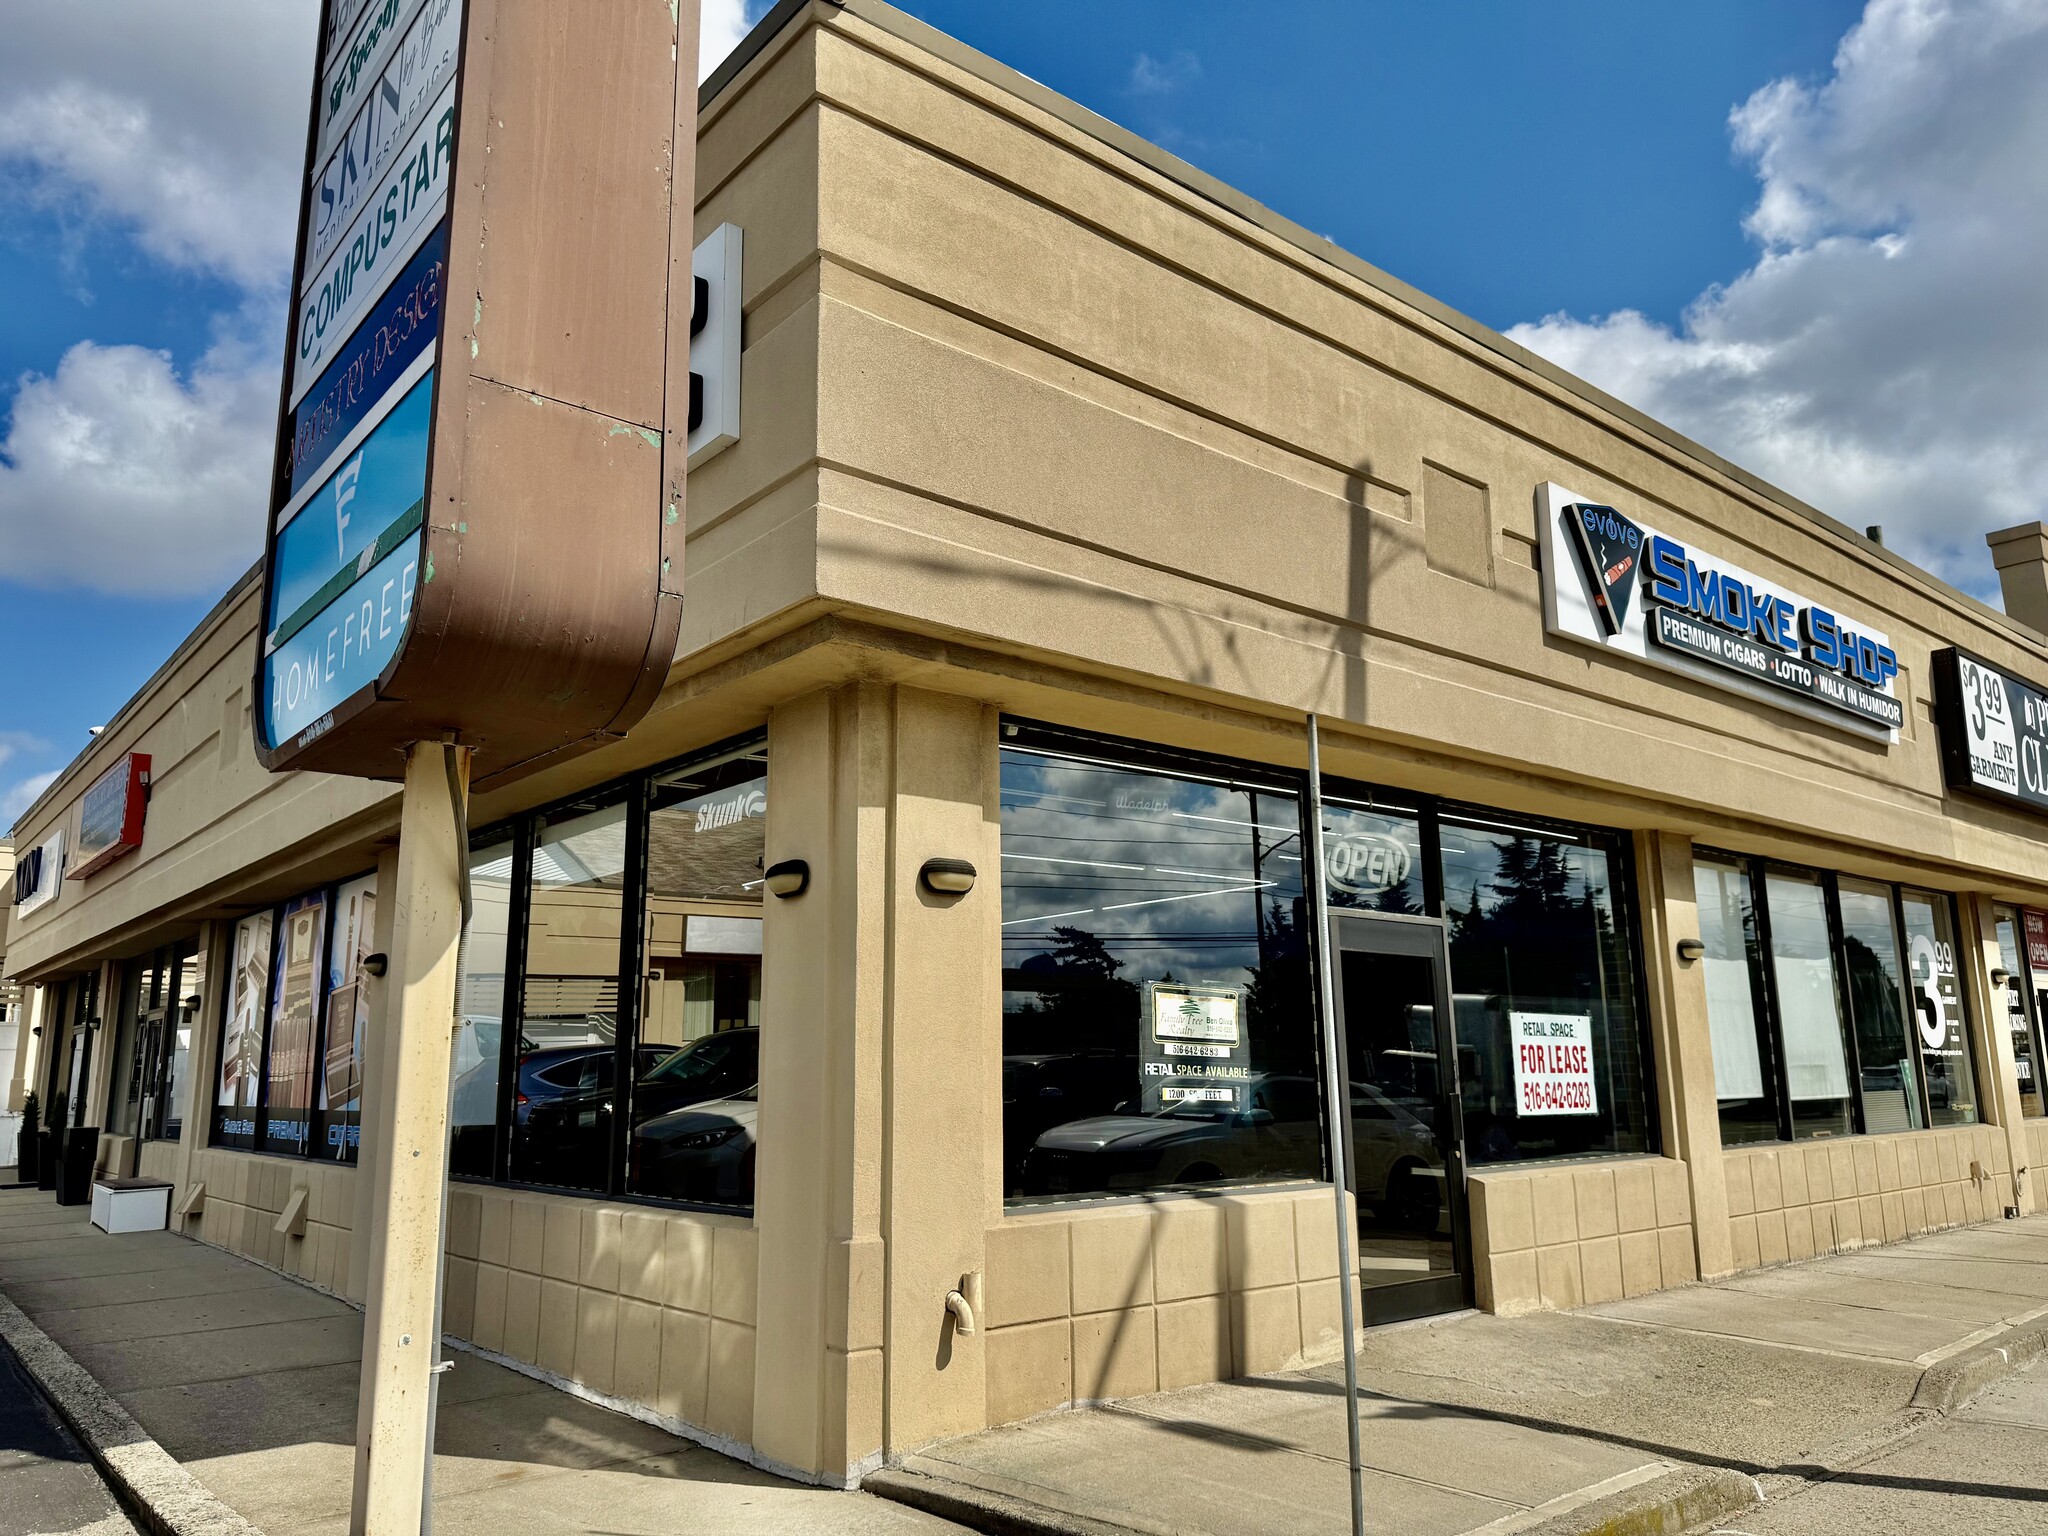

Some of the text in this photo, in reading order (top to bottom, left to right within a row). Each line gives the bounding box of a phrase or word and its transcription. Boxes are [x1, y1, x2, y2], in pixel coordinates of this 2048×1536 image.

[318, 41, 404, 236] SKIN
[301, 106, 454, 360] COMPUSTAR
[1650, 535, 1898, 689] SMOKE SHOP
[271, 560, 415, 726] HOMEFREE
[1663, 615, 1901, 722] PREMIUM CIGARS LOTTO WALK IN HUMIDOR
[1993, 741, 2013, 764] ANY
[1970, 755, 2016, 786] GARMENT
[694, 793, 746, 833] Skunk
[1330, 841, 1401, 886] OPEN
[1167, 1024, 1196, 1036] Realty
[1186, 1014, 1203, 1025] Tree
[1206, 1016, 1217, 1024] Ben
[1523, 1022, 1574, 1038] RETAIL SPACE
[1145, 1063, 1248, 1079] RETAIL SPACE AVAILABLE
[1520, 1044, 1588, 1073] FOR LEASE
[1523, 1081, 1591, 1110] 516-642-6283
